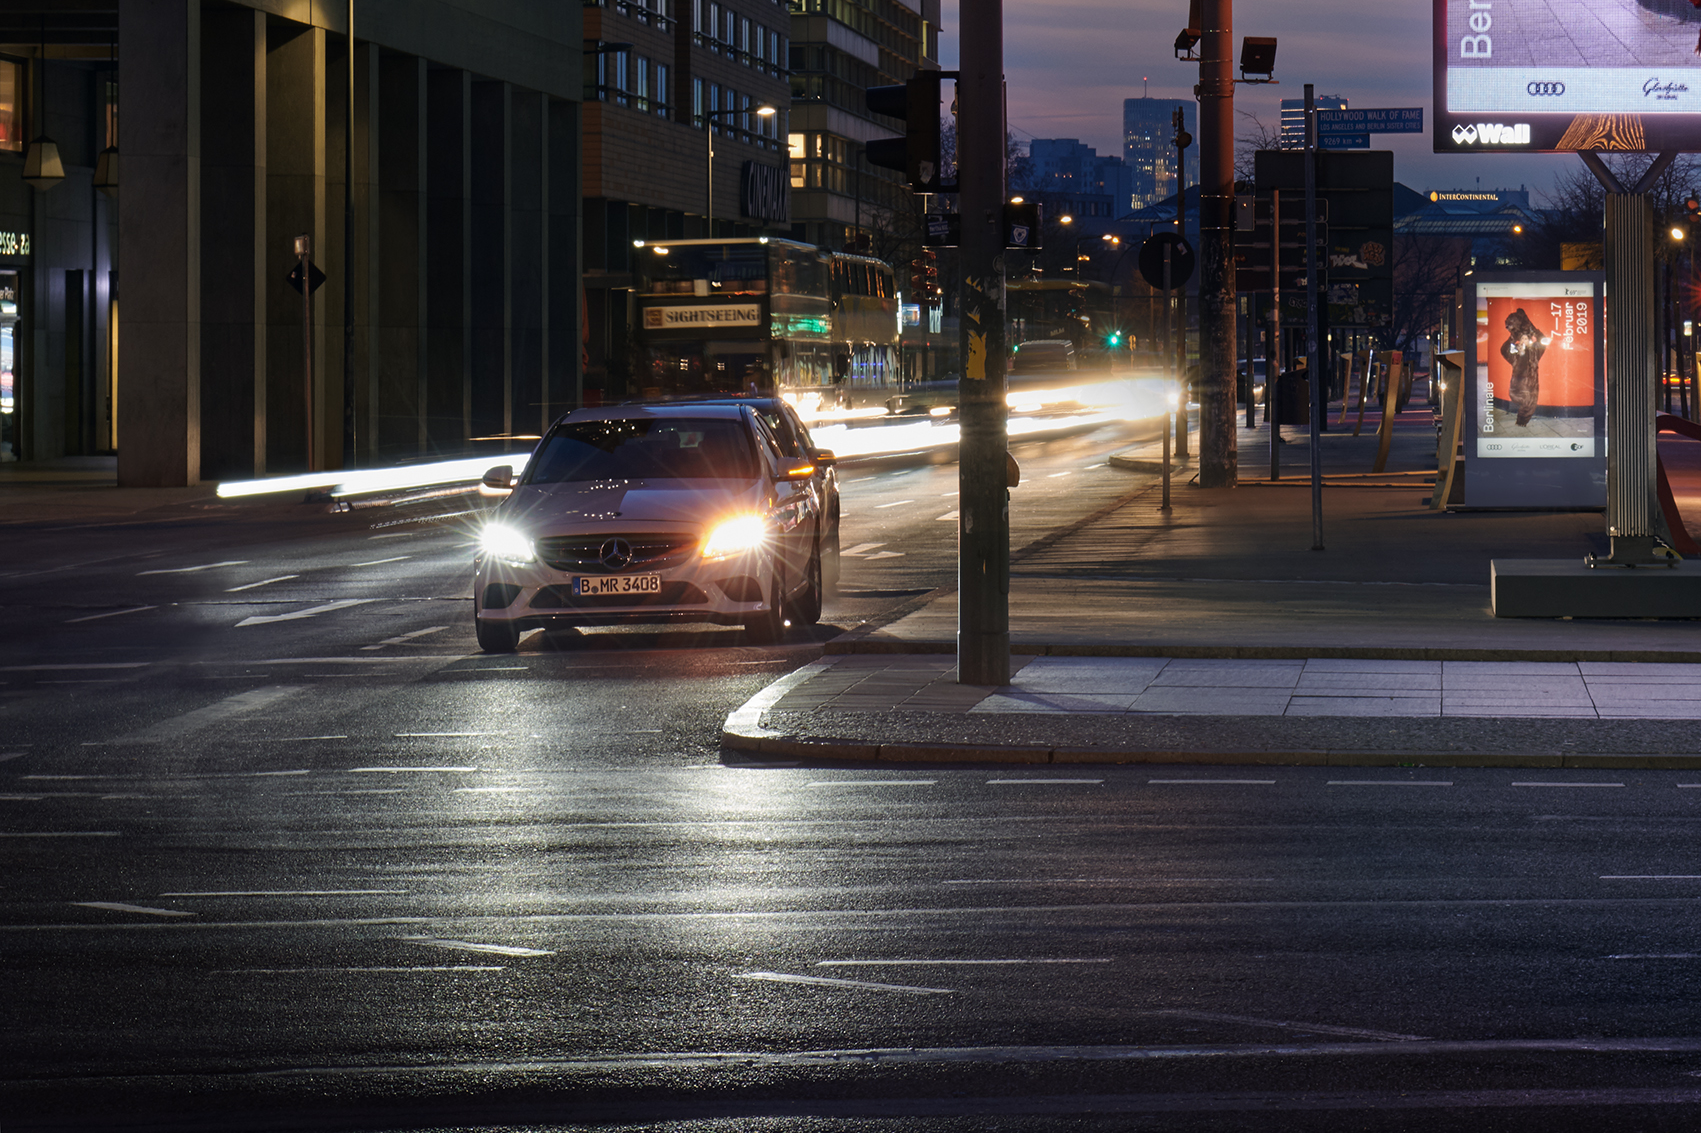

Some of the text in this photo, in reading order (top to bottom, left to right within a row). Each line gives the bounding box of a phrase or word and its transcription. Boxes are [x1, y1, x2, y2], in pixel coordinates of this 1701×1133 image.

[1320, 110, 1420, 121] HOLLYWOOD WALK OF FAME
[1324, 137, 1340, 145] 9269
[1478, 123, 1530, 145] Wall
[666, 306, 757, 323] SIGHTSEEING
[1577, 302, 1588, 334] 2019
[1563, 302, 1574, 350] Februar
[1483, 382, 1494, 432] Berlinale
[581, 576, 659, 593] B MR 3408
